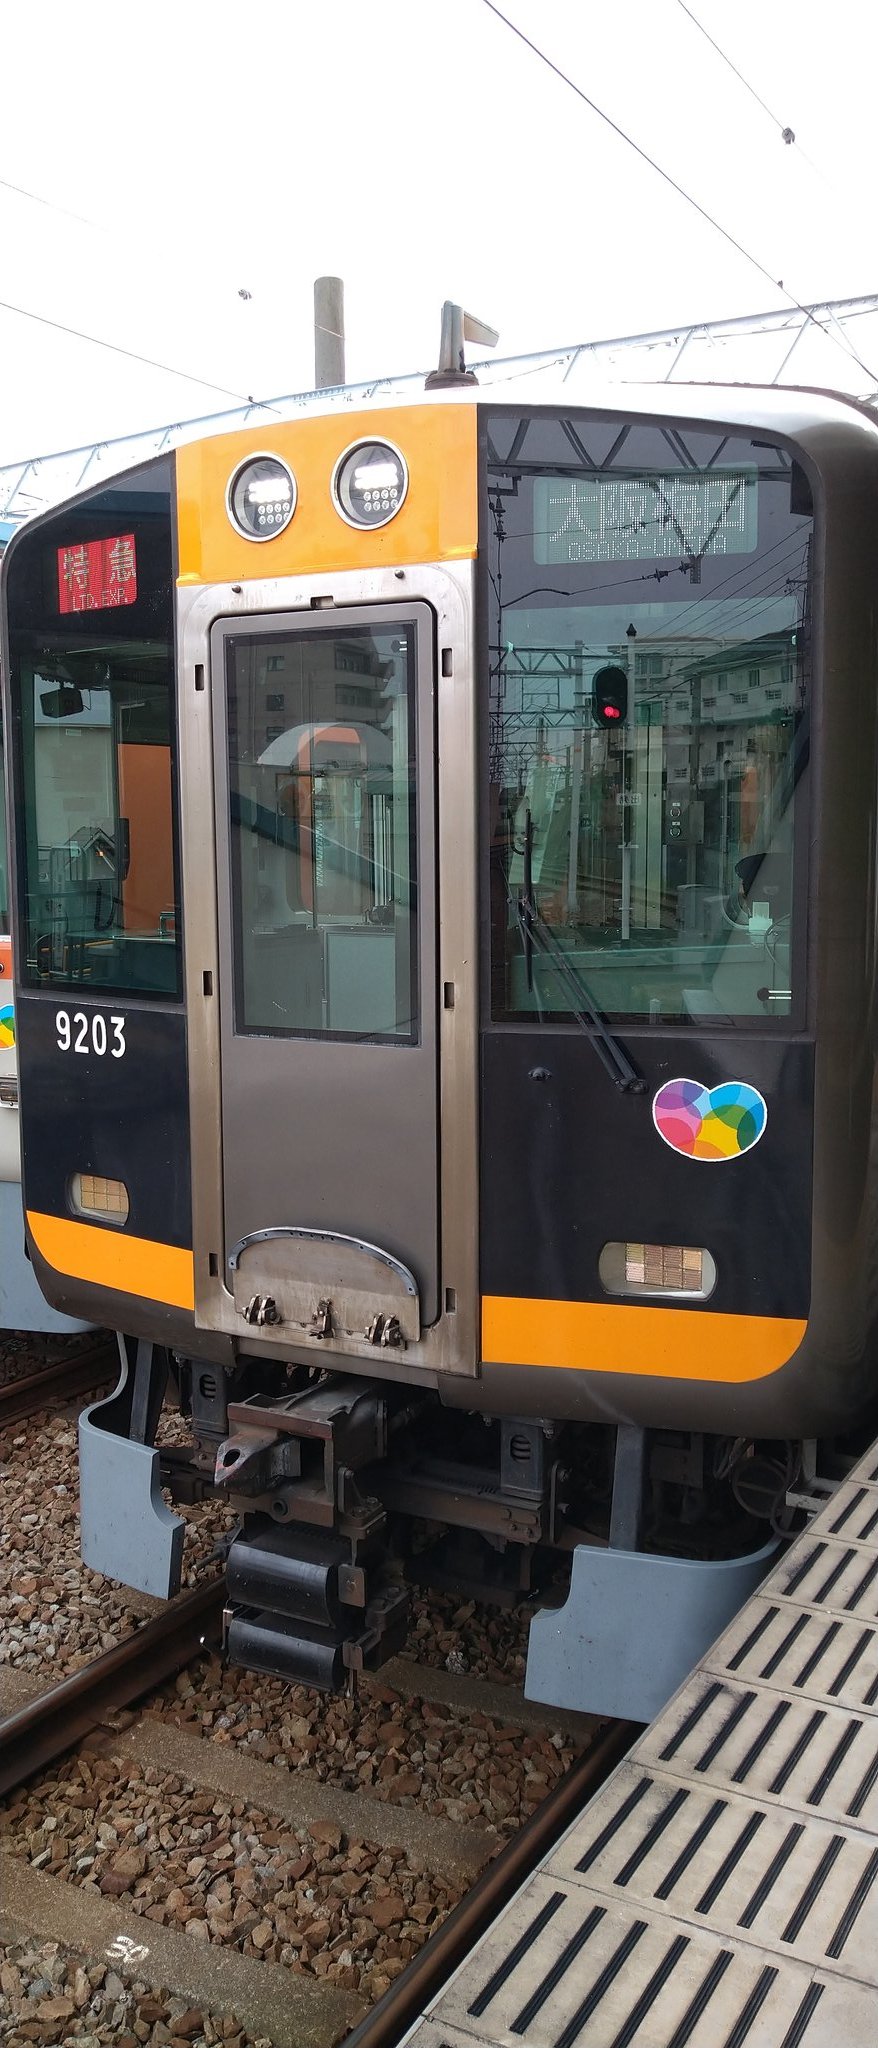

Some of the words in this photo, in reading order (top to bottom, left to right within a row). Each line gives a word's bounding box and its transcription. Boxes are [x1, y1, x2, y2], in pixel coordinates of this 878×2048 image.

[549, 478, 746, 542] 大阪梅田
[63, 539, 137, 590] 特急
[568, 533, 727, 560] OSAKA-UMEDA
[55, 1010, 126, 1058] 9203
[104, 1935, 150, 1963] 30
